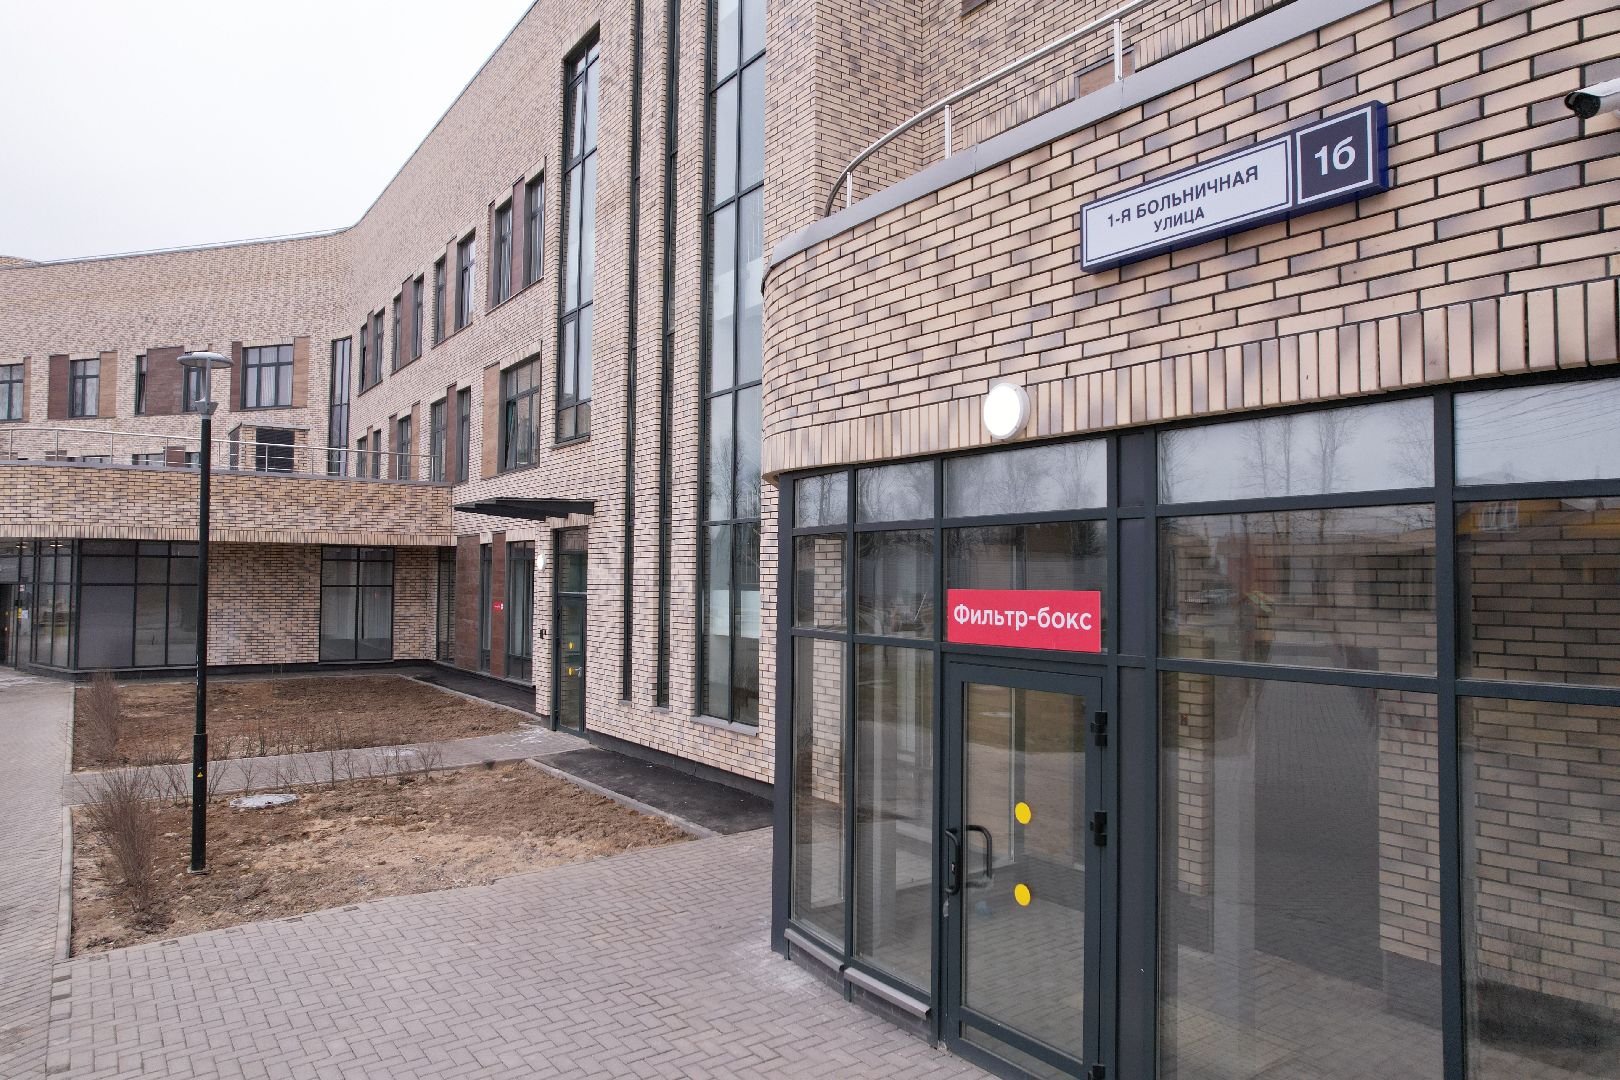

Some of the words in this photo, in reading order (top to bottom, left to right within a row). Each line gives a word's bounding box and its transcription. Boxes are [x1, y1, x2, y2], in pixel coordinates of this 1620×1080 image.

[1314, 135, 1356, 177] 1б
[1107, 208, 1131, 228] 1-Я
[1136, 165, 1259, 219] БОЛЬНИЧНАЯ
[1153, 206, 1205, 233] УЛИЦА
[953, 603, 1092, 631] Фильтр-бокс
